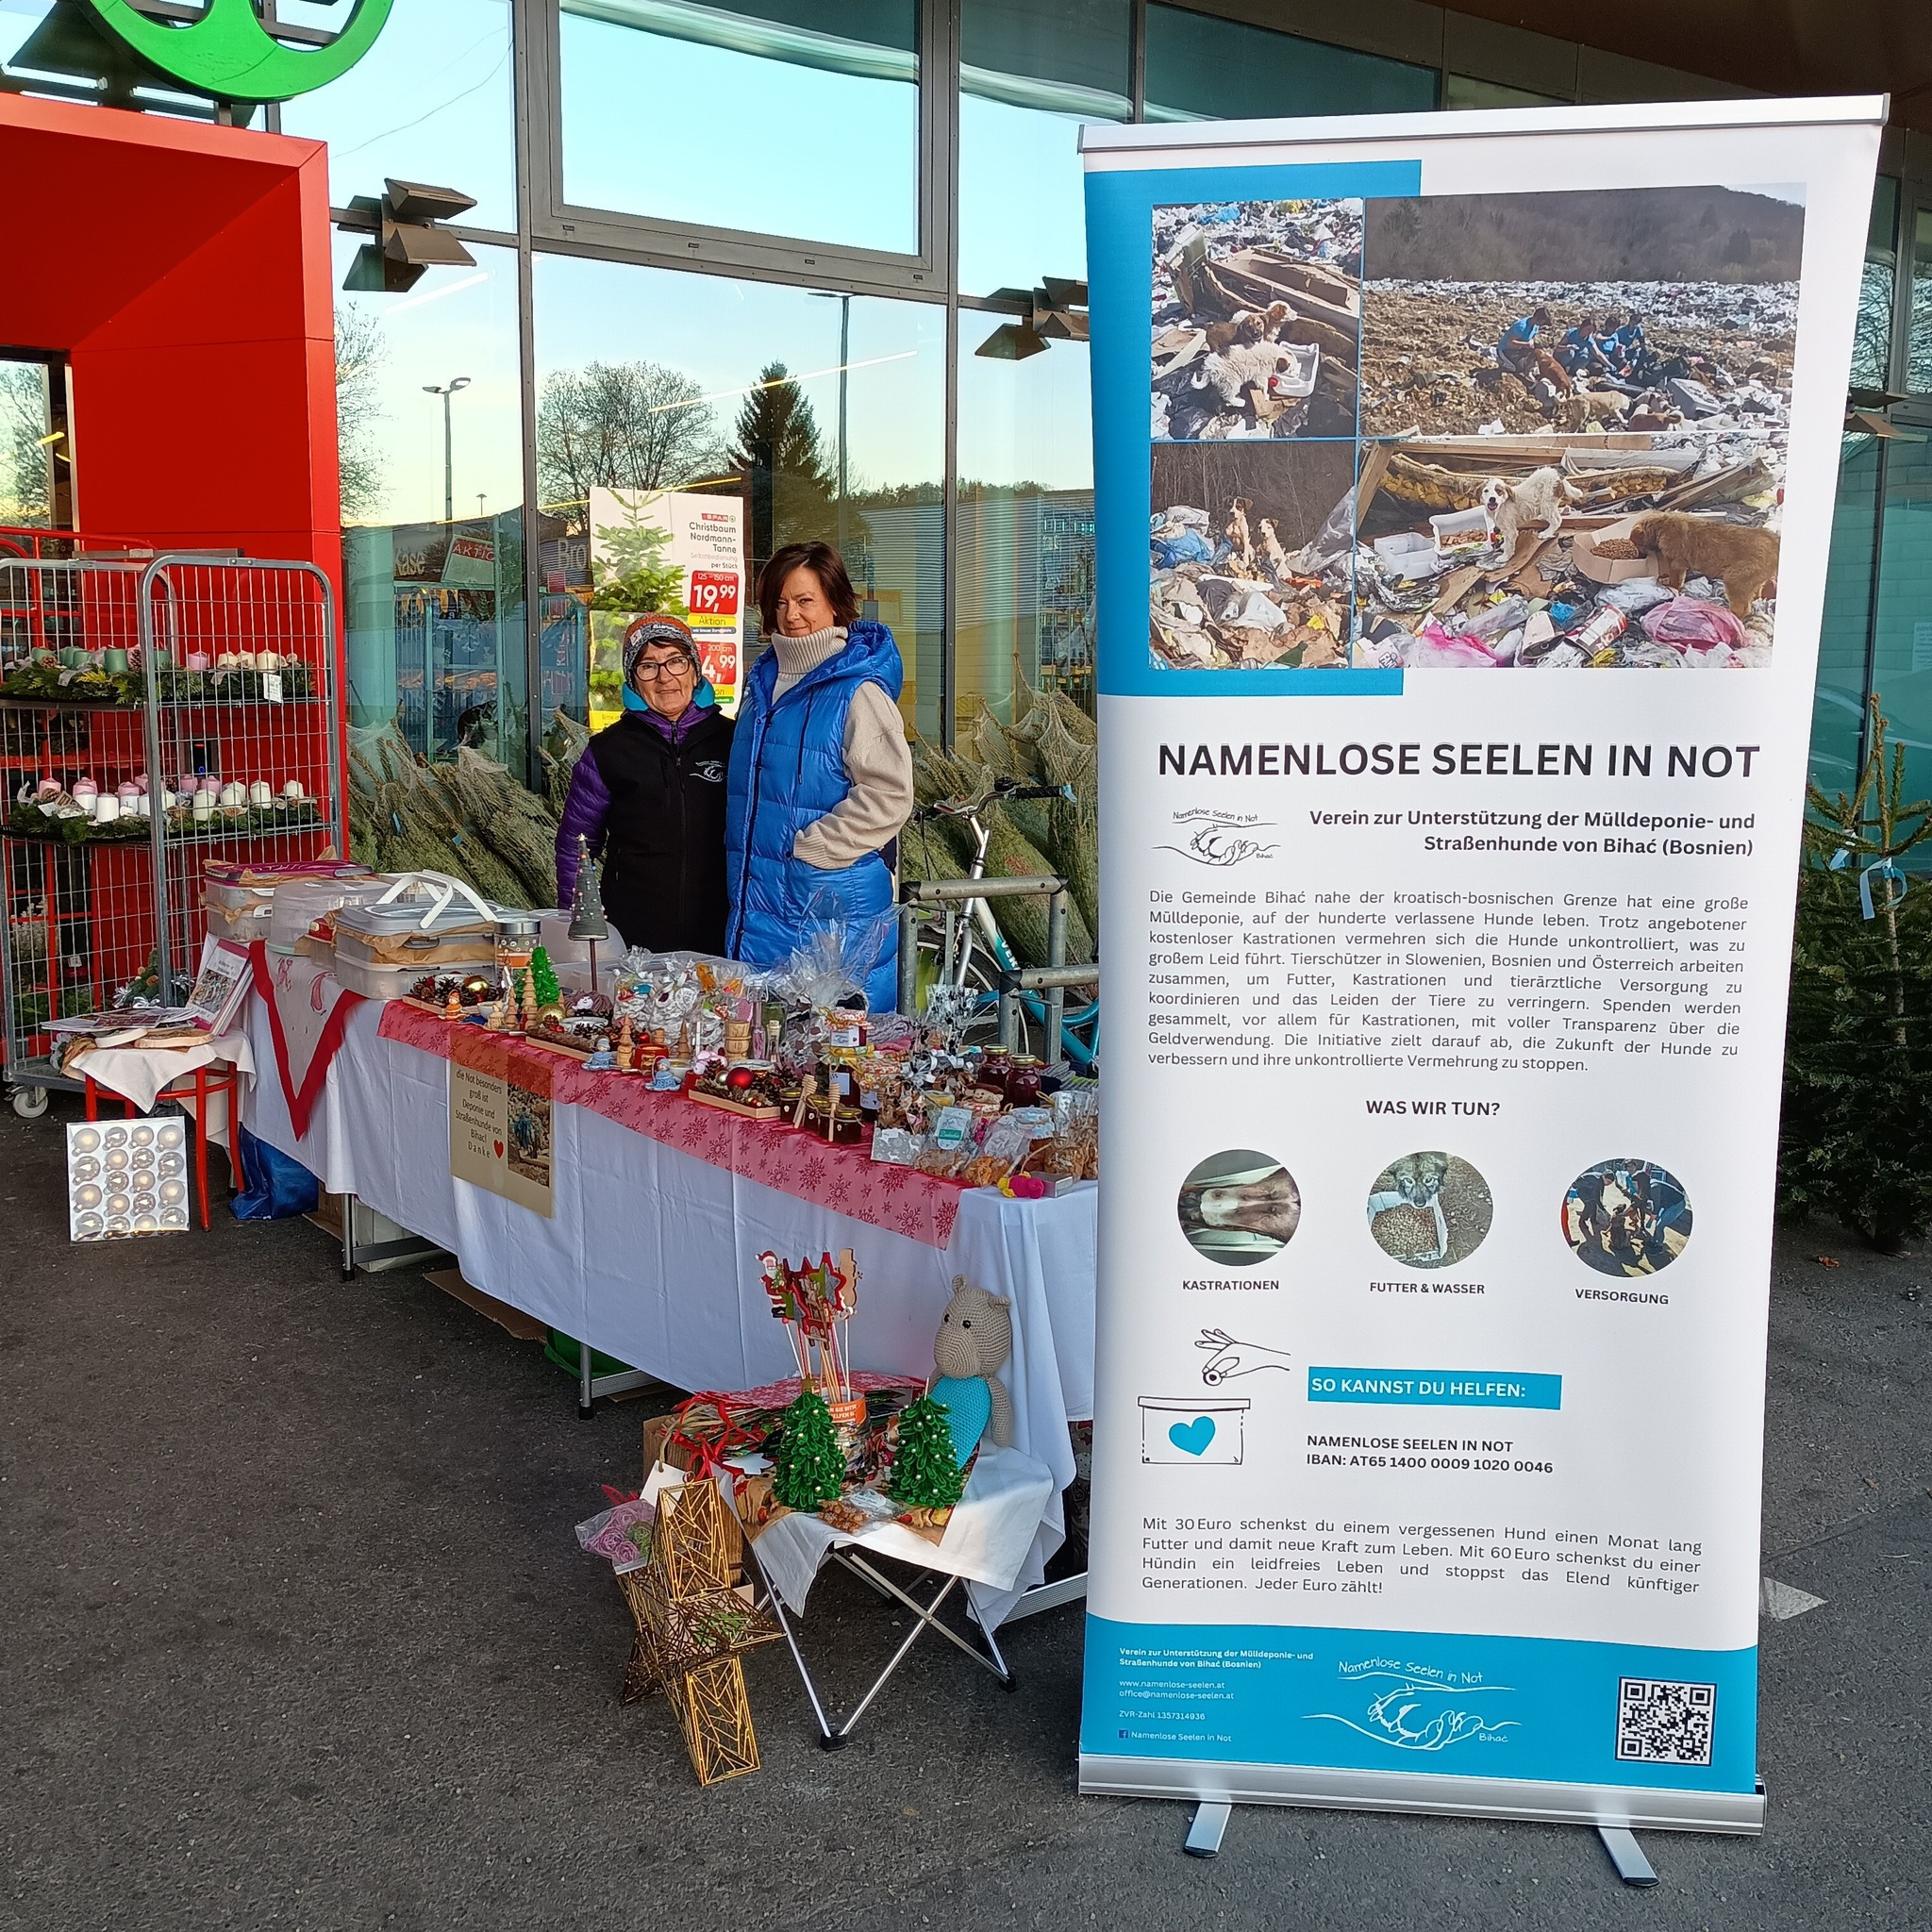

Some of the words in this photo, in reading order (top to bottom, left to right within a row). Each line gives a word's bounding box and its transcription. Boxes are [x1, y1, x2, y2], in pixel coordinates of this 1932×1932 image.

[689, 522, 737, 533] Christbaum
[691, 532, 737, 542] Nordmann-
[453, 543, 494, 560] AKTIO
[713, 543, 737, 554] Tanne
[691, 552, 738, 562] Selbstbedienung
[699, 616, 726, 625] Aktion
[708, 643, 721, 652] 200
[701, 655, 736, 683] 4,99
[1159, 744, 1420, 775] NAMENLOSE
[1432, 744, 1591, 775] SEELEN
[1608, 745, 1651, 776] IN
[1668, 746, 1759, 777] NOT
[1173, 808, 1209, 820] Namenlose
[1212, 809, 1236, 821] Seelen
[1237, 813, 1243, 822] in
[1245, 814, 1258, 823] Not
[1310, 810, 1368, 824] Verein
[1374, 814, 1403, 824] zur
[1408, 810, 1541, 829] Unterstützung
[1547, 811, 1579, 825] der
[1585, 812, 1713, 831] Mülldeponie-
[1720, 814, 1755, 828] und
[1424, 836, 1557, 851] Straßenhunde
[1563, 841, 1597, 852] von
[1605, 838, 1657, 853] Bihać
[1663, 840, 1752, 856] (Bosnien)
[1151, 891, 1173, 903] Die
[1182, 891, 1256, 903] Gemeinde
[1266, 891, 1305, 903] Bihać
[1315, 891, 1350, 903] nahe
[1360, 891, 1384, 903] der
[1394, 891, 1553, 905] kroatisch-bosnischen
[1564, 894, 1617, 907] Grenze
[1627, 895, 1652, 908] hat
[1662, 896, 1694, 908] eine
[1705, 897, 1748, 912] große
[1150, 911, 1242, 926] Mülldeponie,
[1253, 911, 1276, 924] auf
[1285, 912, 1309, 924] der
[1319, 912, 1386, 924] hunderte
[1395, 912, 1474, 924] verlassene
[1485, 913, 1533, 925] Hunde
[1543, 914, 1589, 926] leben.
[1599, 916, 1639, 928] Trotz
[1648, 918, 1747, 933] angebotener
[1148, 1053, 1226, 1065] verbessern
[1232, 1054, 1258, 1065] und
[1264, 1054, 1291, 1065] ihre
[1295, 1054, 1403, 1066] unkontrollierte
[1407, 1055, 1498, 1071] Vermehrung
[1502, 1059, 1517, 1068] zu
[1523, 1058, 1588, 1072] stoppen.
[465, 1072, 475, 1084] Not
[475, 1076, 502, 1094] besonders
[462, 1099, 484, 1115] Deponie
[485, 1108, 495, 1119] und
[1366, 1101, 1407, 1114] WAS
[1412, 1102, 1446, 1114] WIR
[1452, 1102, 1500, 1115] TUN?
[455, 1109, 491, 1131] Straßenhunde
[492, 1124, 502, 1136] von
[1183, 1281, 1278, 1290] KASTRATIONEN
[1371, 1283, 1417, 1292] FUTTER
[1421, 1284, 1429, 1292] &
[1433, 1284, 1484, 1293] WASSER
[1575, 1289, 1668, 1304] VERSORGUNG
[1311, 1377, 1336, 1393] SO
[1341, 1379, 1414, 1393] KANNST
[1420, 1382, 1444, 1394] DU
[1451, 1382, 1525, 1397] HELFEN:
[1307, 1436, 1399, 1448] NAMENLOSE
[1403, 1439, 1457, 1450] SEELEN
[1463, 1441, 1476, 1450] IN
[1482, 1441, 1513, 1452] NOT
[1307, 1454, 1345, 1465] IBAN:
[1350, 1456, 1386, 1467] AT65
[1391, 1457, 1426, 1468] 1400
[1431, 1458, 1470, 1469] 0009
[1474, 1459, 1509, 1471] 1020
[1514, 1461, 1553, 1473] 0046
[1143, 1518, 1167, 1529] Mit
[1198, 1519, 1231, 1529] Euro
[1241, 1518, 1307, 1530] schenkst
[1316, 1520, 1334, 1531] du
[1344, 1521, 1389, 1534] einem
[1399, 1526, 1494, 1539] vergessenen
[1506, 1527, 1545, 1540] Hund
[1556, 1530, 1597, 1544] einen
[1608, 1535, 1658, 1549] Monat
[1670, 1540, 1701, 1556] lang
[1143, 1538, 1189, 1549] Futter
[1195, 1538, 1222, 1549] und
[1229, 1538, 1272, 1549] damit
[1279, 1541, 1315, 1551] neue
[1323, 1541, 1358, 1553] Kraft
[1365, 1544, 1395, 1554] zum
[1404, 1543, 1452, 1556] Leben.
[1460, 1546, 1484, 1557] Mit
[1515, 1548, 1549, 1560] Euro
[1557, 1551, 1626, 1567] schenkst
[1633, 1557, 1653, 1569] du
[1660, 1559, 1700, 1573] einer
[1119, 1647, 1147, 1656] Verein
[1162, 1649, 1223, 1659] Unterstützung
[1224, 1649, 1239, 1657] der
[1240, 1650, 1296, 1659] Mülldeponie-
[1296, 1652, 1314, 1660] und
[1119, 1657, 1178, 1667] Straßenhunde
[1197, 1659, 1221, 1668] Bihać
[1222, 1660, 1262, 1669] (Bosnien)
[1338, 1657, 1401, 1674] Namenlose
[1405, 1661, 1443, 1679] Seelen
[1447, 1670, 1457, 1683] in
[1461, 1672, 1483, 1684] Not
[1119, 1680, 1225, 1690] www.namenlose-seelen.at
[1119, 1690, 1235, 1700] office@namenlose-seelen.at
[1119, 1709, 1156, 1719] ZVR-Zahl
[1157, 1711, 1206, 1721] 1357314936
[1131, 1731, 1176, 1740] Namenlose
[1178, 1733, 1206, 1741] Seelen
